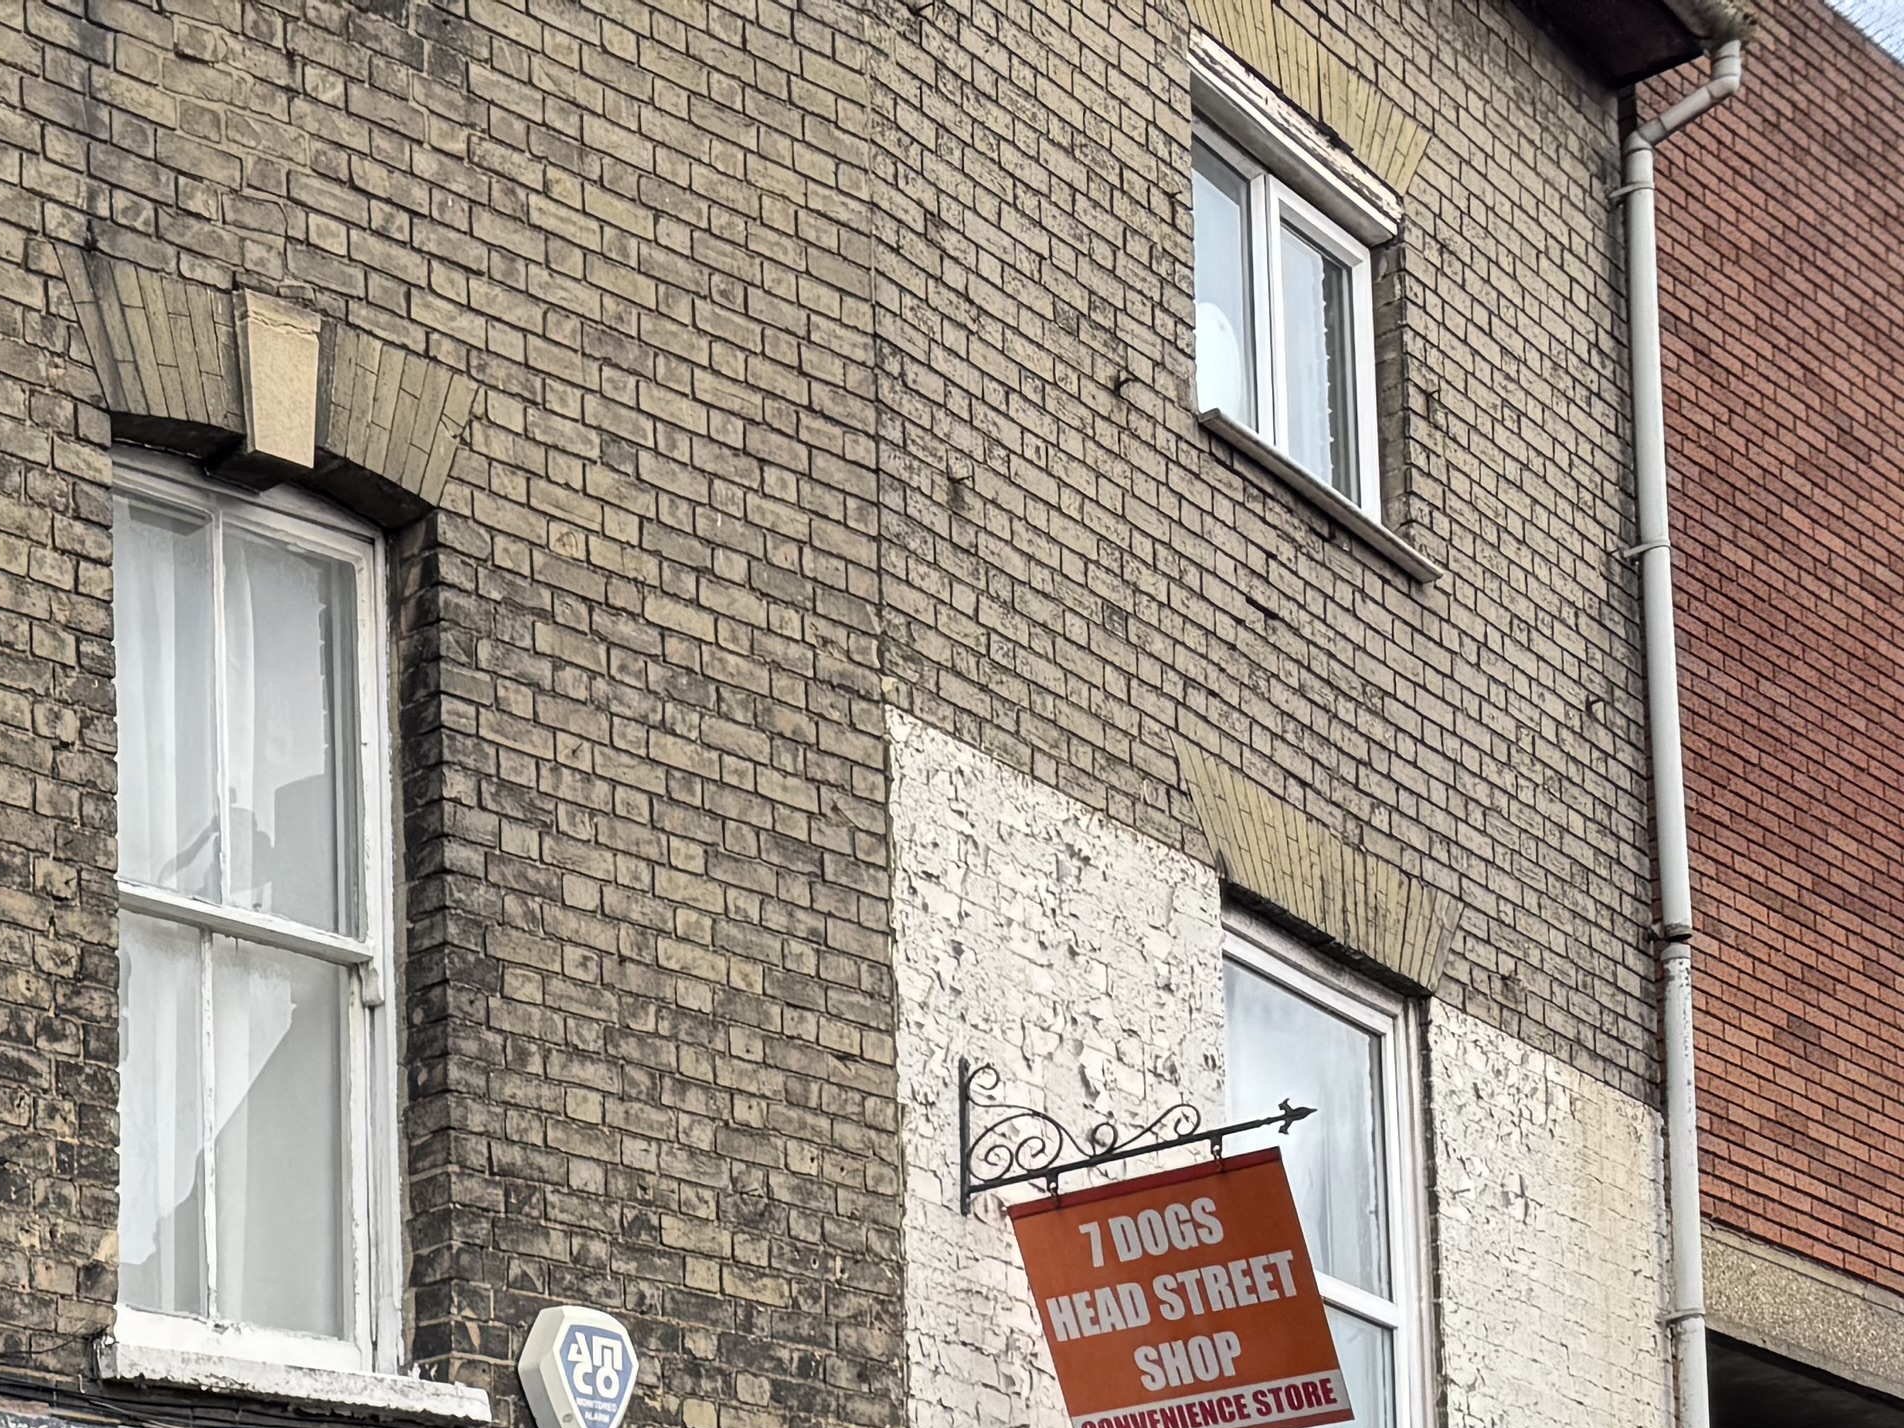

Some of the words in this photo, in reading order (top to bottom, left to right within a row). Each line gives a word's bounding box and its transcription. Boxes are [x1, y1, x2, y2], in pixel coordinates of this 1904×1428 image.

[1078, 1221, 1105, 1269] 7
[1108, 1197, 1224, 1263] DOGS
[1046, 1282, 1152, 1343] HEAD
[1152, 1250, 1298, 1322] STREET
[1133, 1330, 1242, 1392] SHOP
[1252, 1377, 1339, 1417] STORE
